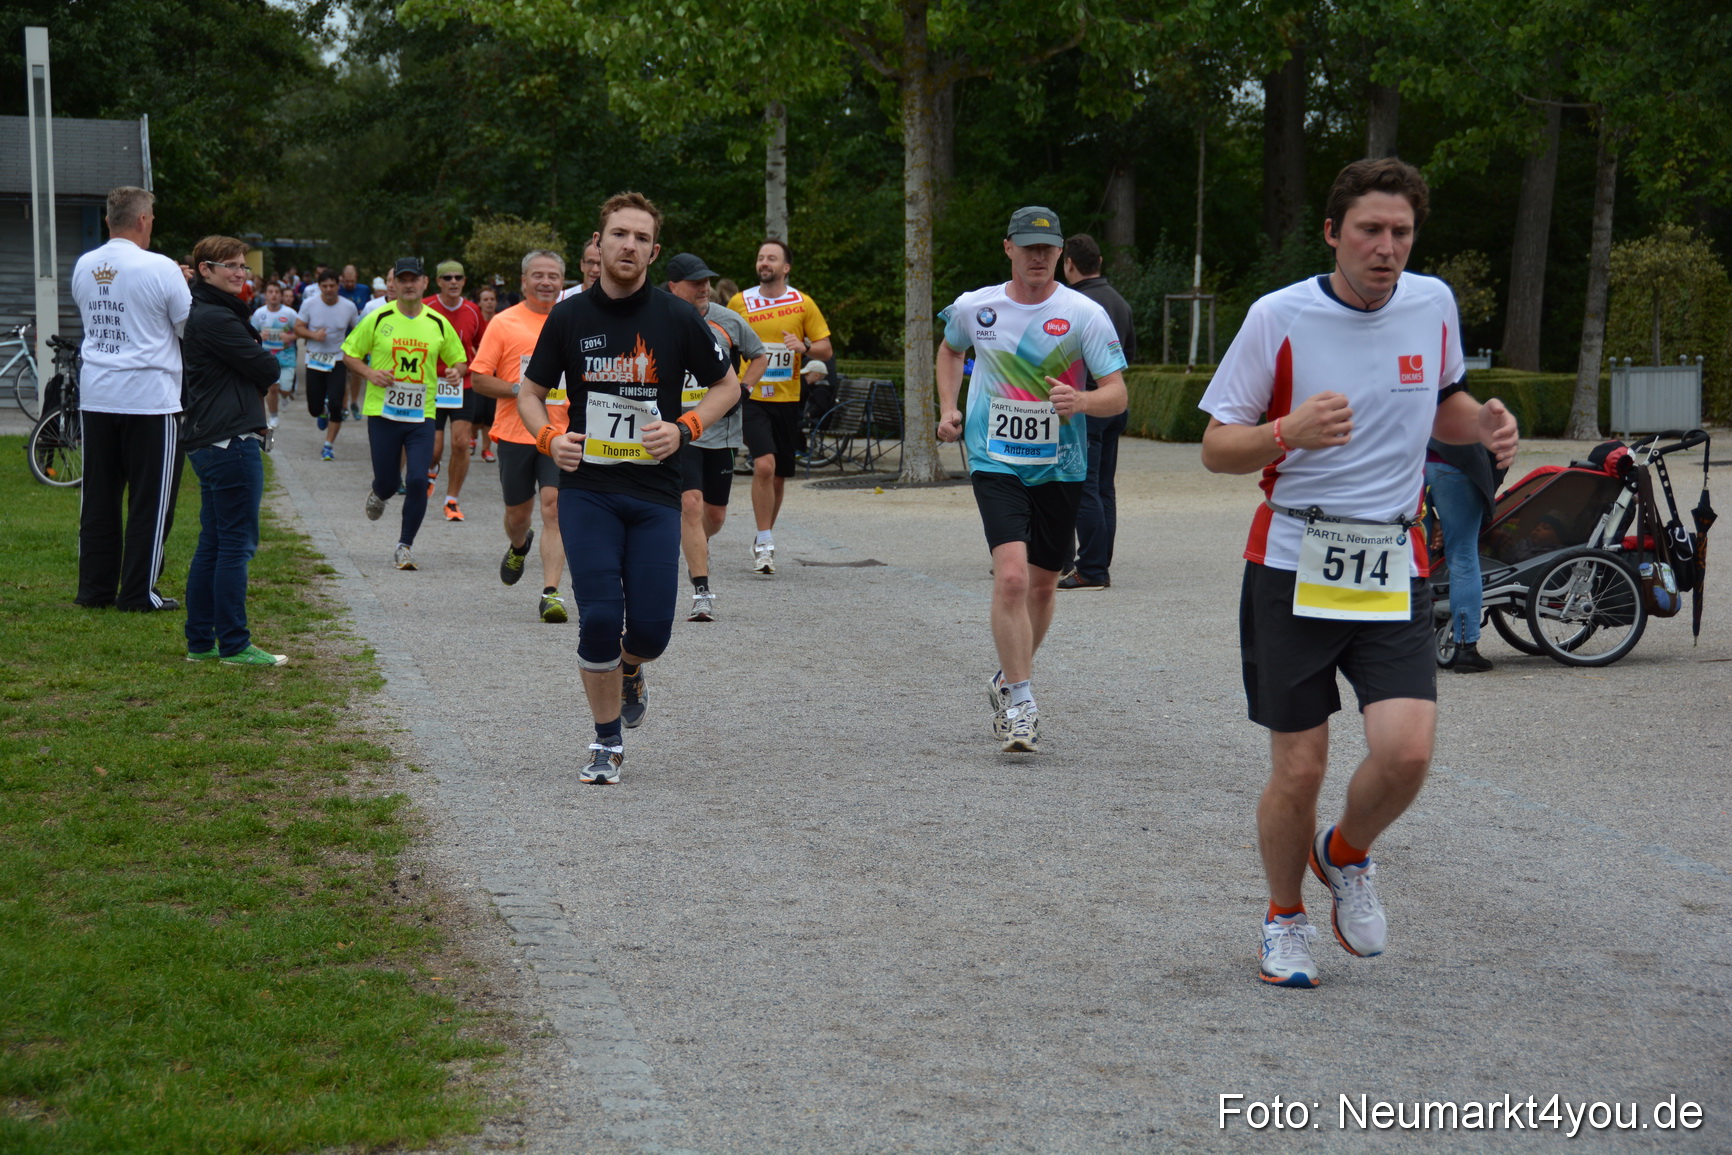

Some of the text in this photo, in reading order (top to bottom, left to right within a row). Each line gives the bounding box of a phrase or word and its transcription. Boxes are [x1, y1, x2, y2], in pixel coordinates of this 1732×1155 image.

[99, 286, 109, 295] IM
[88, 301, 124, 312] AUFTRAG
[92, 315, 120, 326] SEINER
[748, 306, 805, 323] MAX BÖGL
[1047, 323, 1068, 331] Hervis
[96, 343, 119, 354] JESUS
[392, 338, 429, 348] Müller
[584, 339, 602, 349] 2014
[400, 356, 418, 373] M
[585, 357, 633, 372] TOUGH
[765, 352, 791, 366] 719
[584, 372, 634, 383] MUDDER
[1401, 373, 1422, 381] DKMS
[437, 384, 460, 396] 055
[620, 386, 657, 397] FINISHER
[690, 391, 706, 400] Stef
[388, 390, 422, 408] 2818
[589, 399, 648, 414] PARTL Neumarkt
[992, 403, 1048, 414] PARTL Neumarkt
[608, 413, 636, 439] 71
[996, 413, 1050, 440] 2081
[602, 444, 641, 457] Thomas
[1004, 444, 1041, 456] Andreas
[1294, 509, 1341, 523] NAHAN
[1306, 527, 1393, 544] PARTL Neumarkt
[1323, 546, 1389, 586] 514
